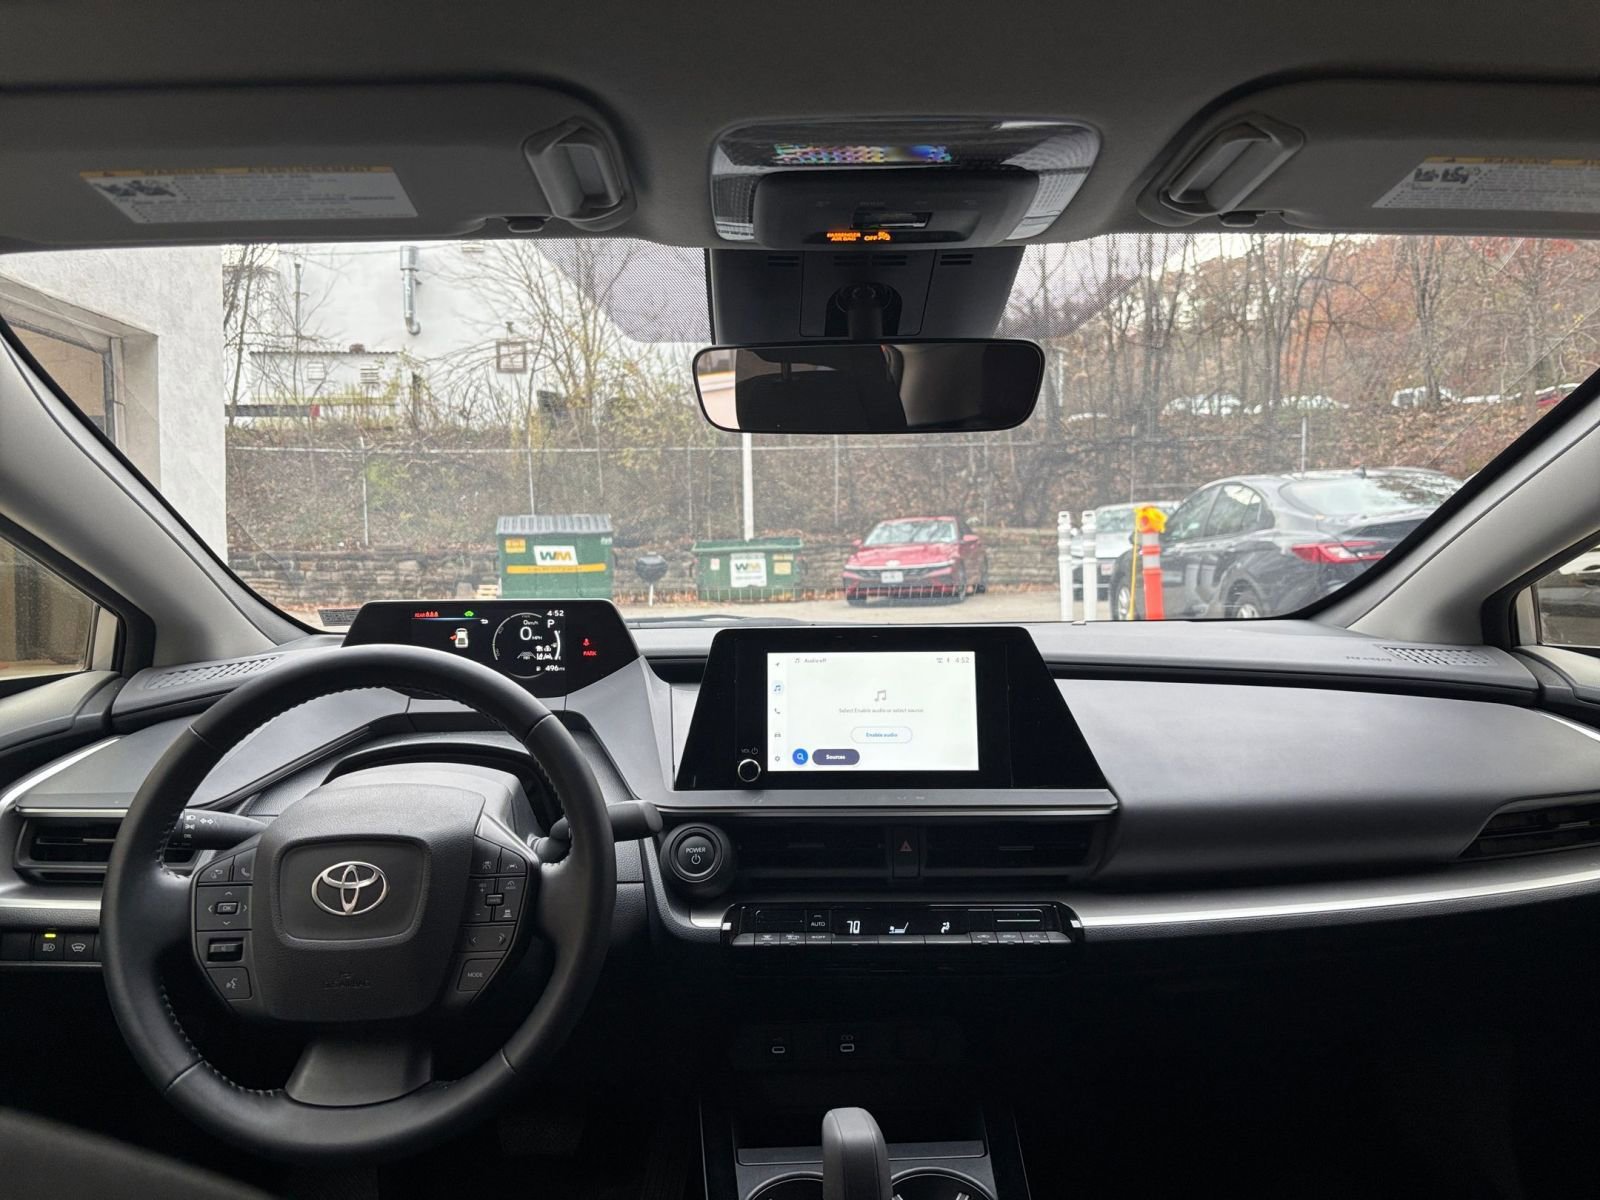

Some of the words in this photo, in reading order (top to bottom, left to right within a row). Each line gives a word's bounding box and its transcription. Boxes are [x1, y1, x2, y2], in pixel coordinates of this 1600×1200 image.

[539, 550, 572, 561] WM
[735, 562, 762, 571] WM
[546, 609, 565, 617] 4:52
[547, 619, 555, 629] P
[520, 626, 532, 641] 0
[846, 920, 861, 935] 70
